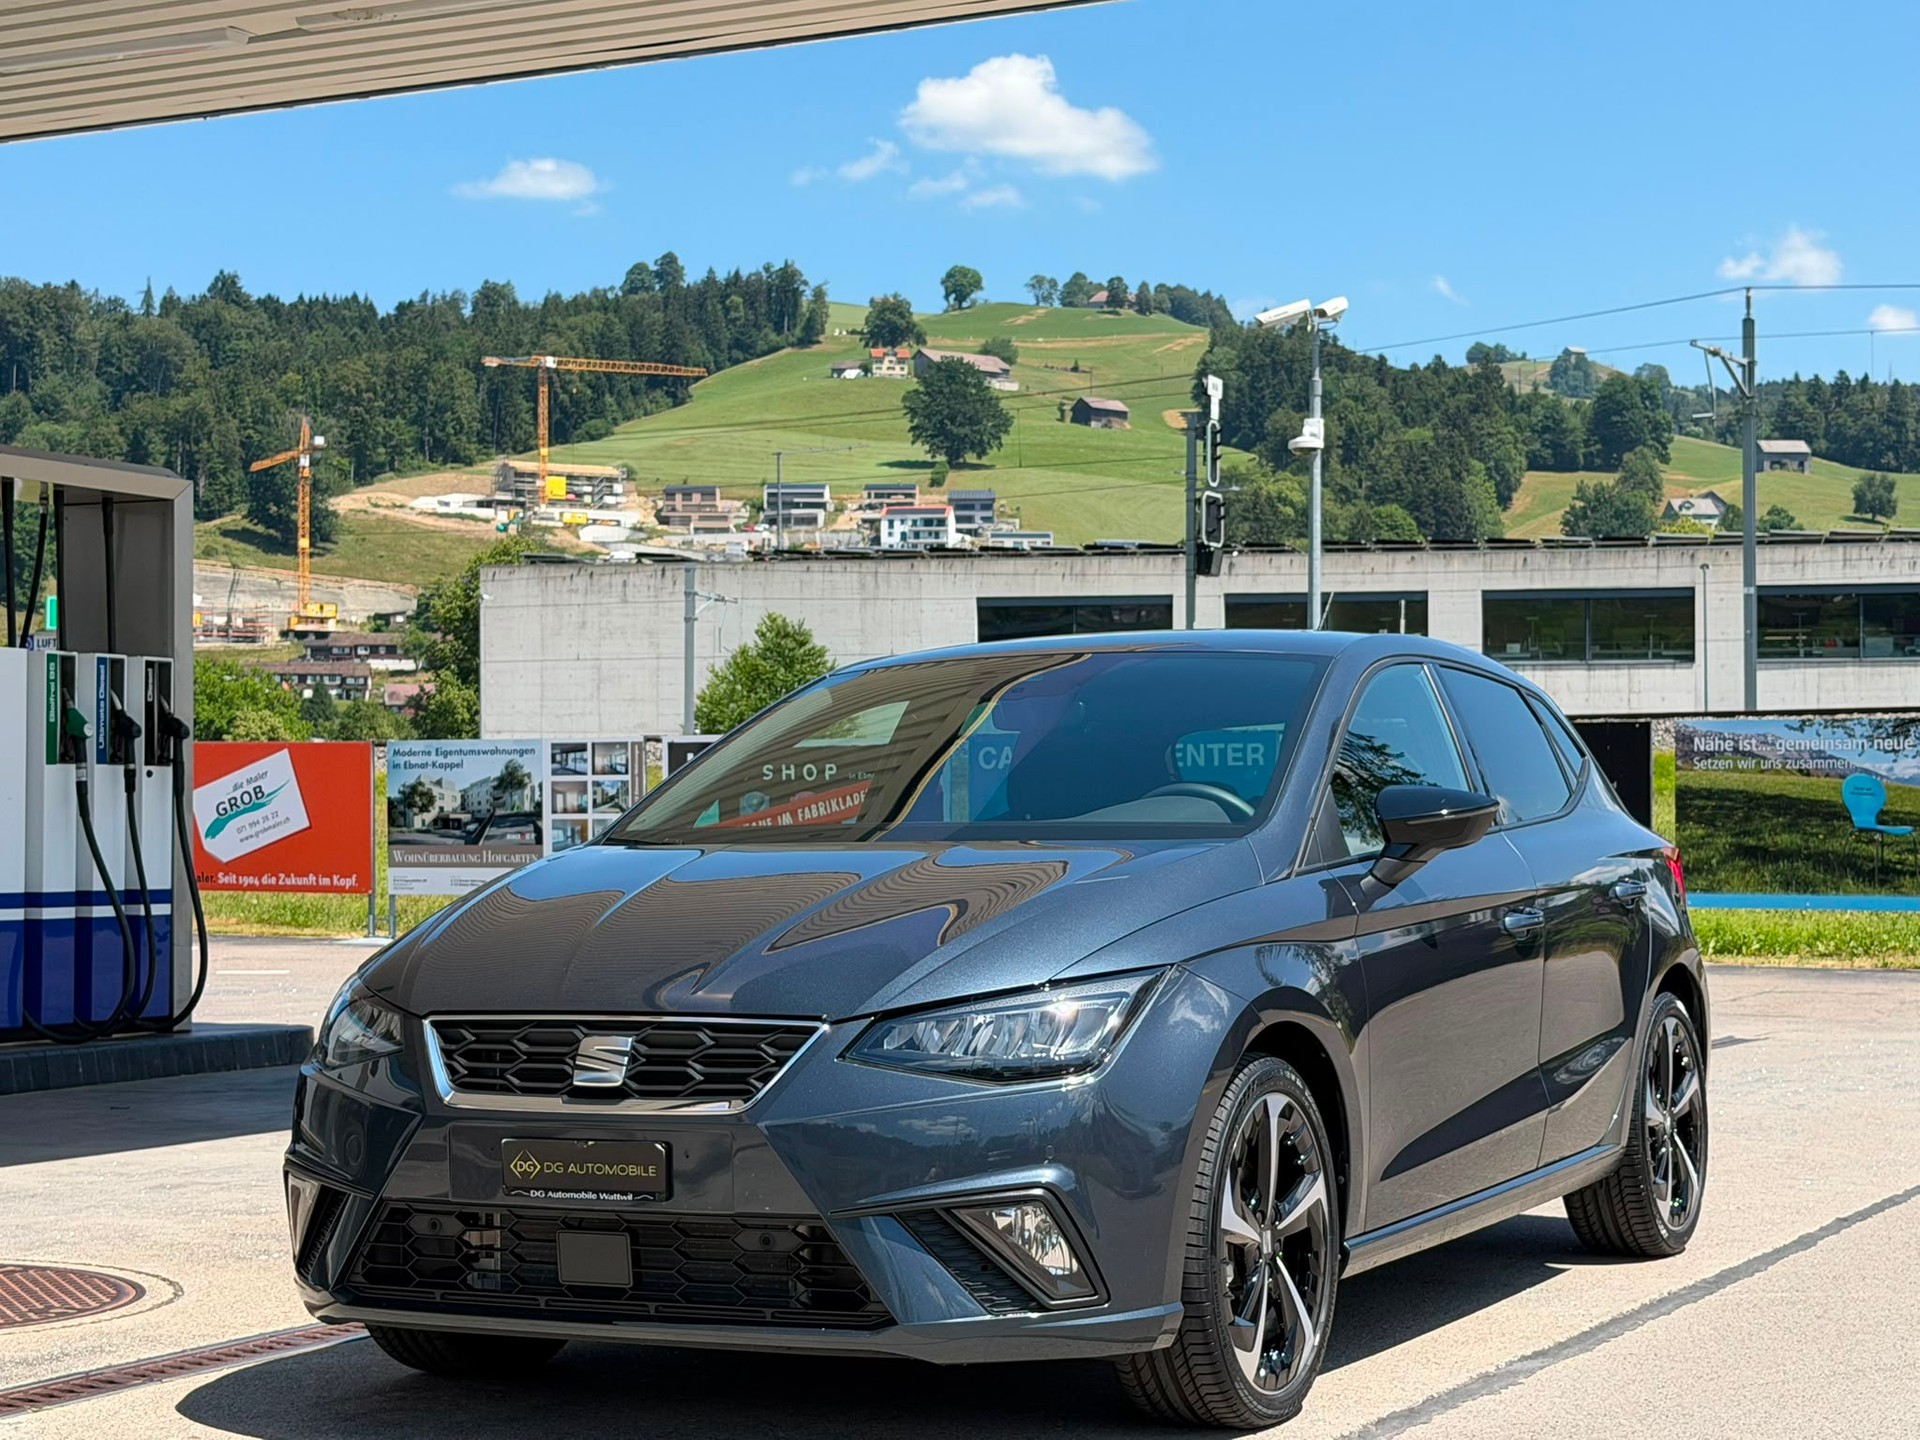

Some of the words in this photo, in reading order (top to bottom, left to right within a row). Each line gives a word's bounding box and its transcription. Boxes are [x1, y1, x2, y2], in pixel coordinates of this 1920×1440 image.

[37, 637, 57, 649] LUFT
[393, 748, 432, 757] Moderne
[435, 746, 535, 759] Eigentumswohnungen
[1693, 736, 1734, 751] Nähe
[1776, 737, 1869, 754] gemeinsam
[1873, 737, 1914, 750] neue
[393, 760, 401, 769] in
[404, 759, 464, 771] Ebnat-Kappel
[1693, 757, 1733, 770] Setzen
[1737, 757, 1756, 769] wir
[1761, 759, 1782, 770] uns
[763, 764, 837, 780] SHOP
[232, 781, 244, 792] die
[246, 770, 268, 786] Maler
[216, 784, 265, 817] GROB
[797, 788, 869, 822] FABRIKLADE
[197, 871, 216, 884] aler.
[218, 872, 237, 884] Seit
[239, 874, 259, 887] 1904
[261, 873, 276, 885] die
[278, 873, 317, 886] Zukunft
[318, 874, 331, 885] im
[333, 874, 358, 889] Kopf.
[516, 1161, 534, 1172] DG
[544, 1162, 564, 1173] DG
[567, 1163, 657, 1177] AUTOMOBILE
[530, 1190, 545, 1198] DG
[547, 1190, 597, 1199] Automobile
[599, 1192, 633, 1201] Wattwil
